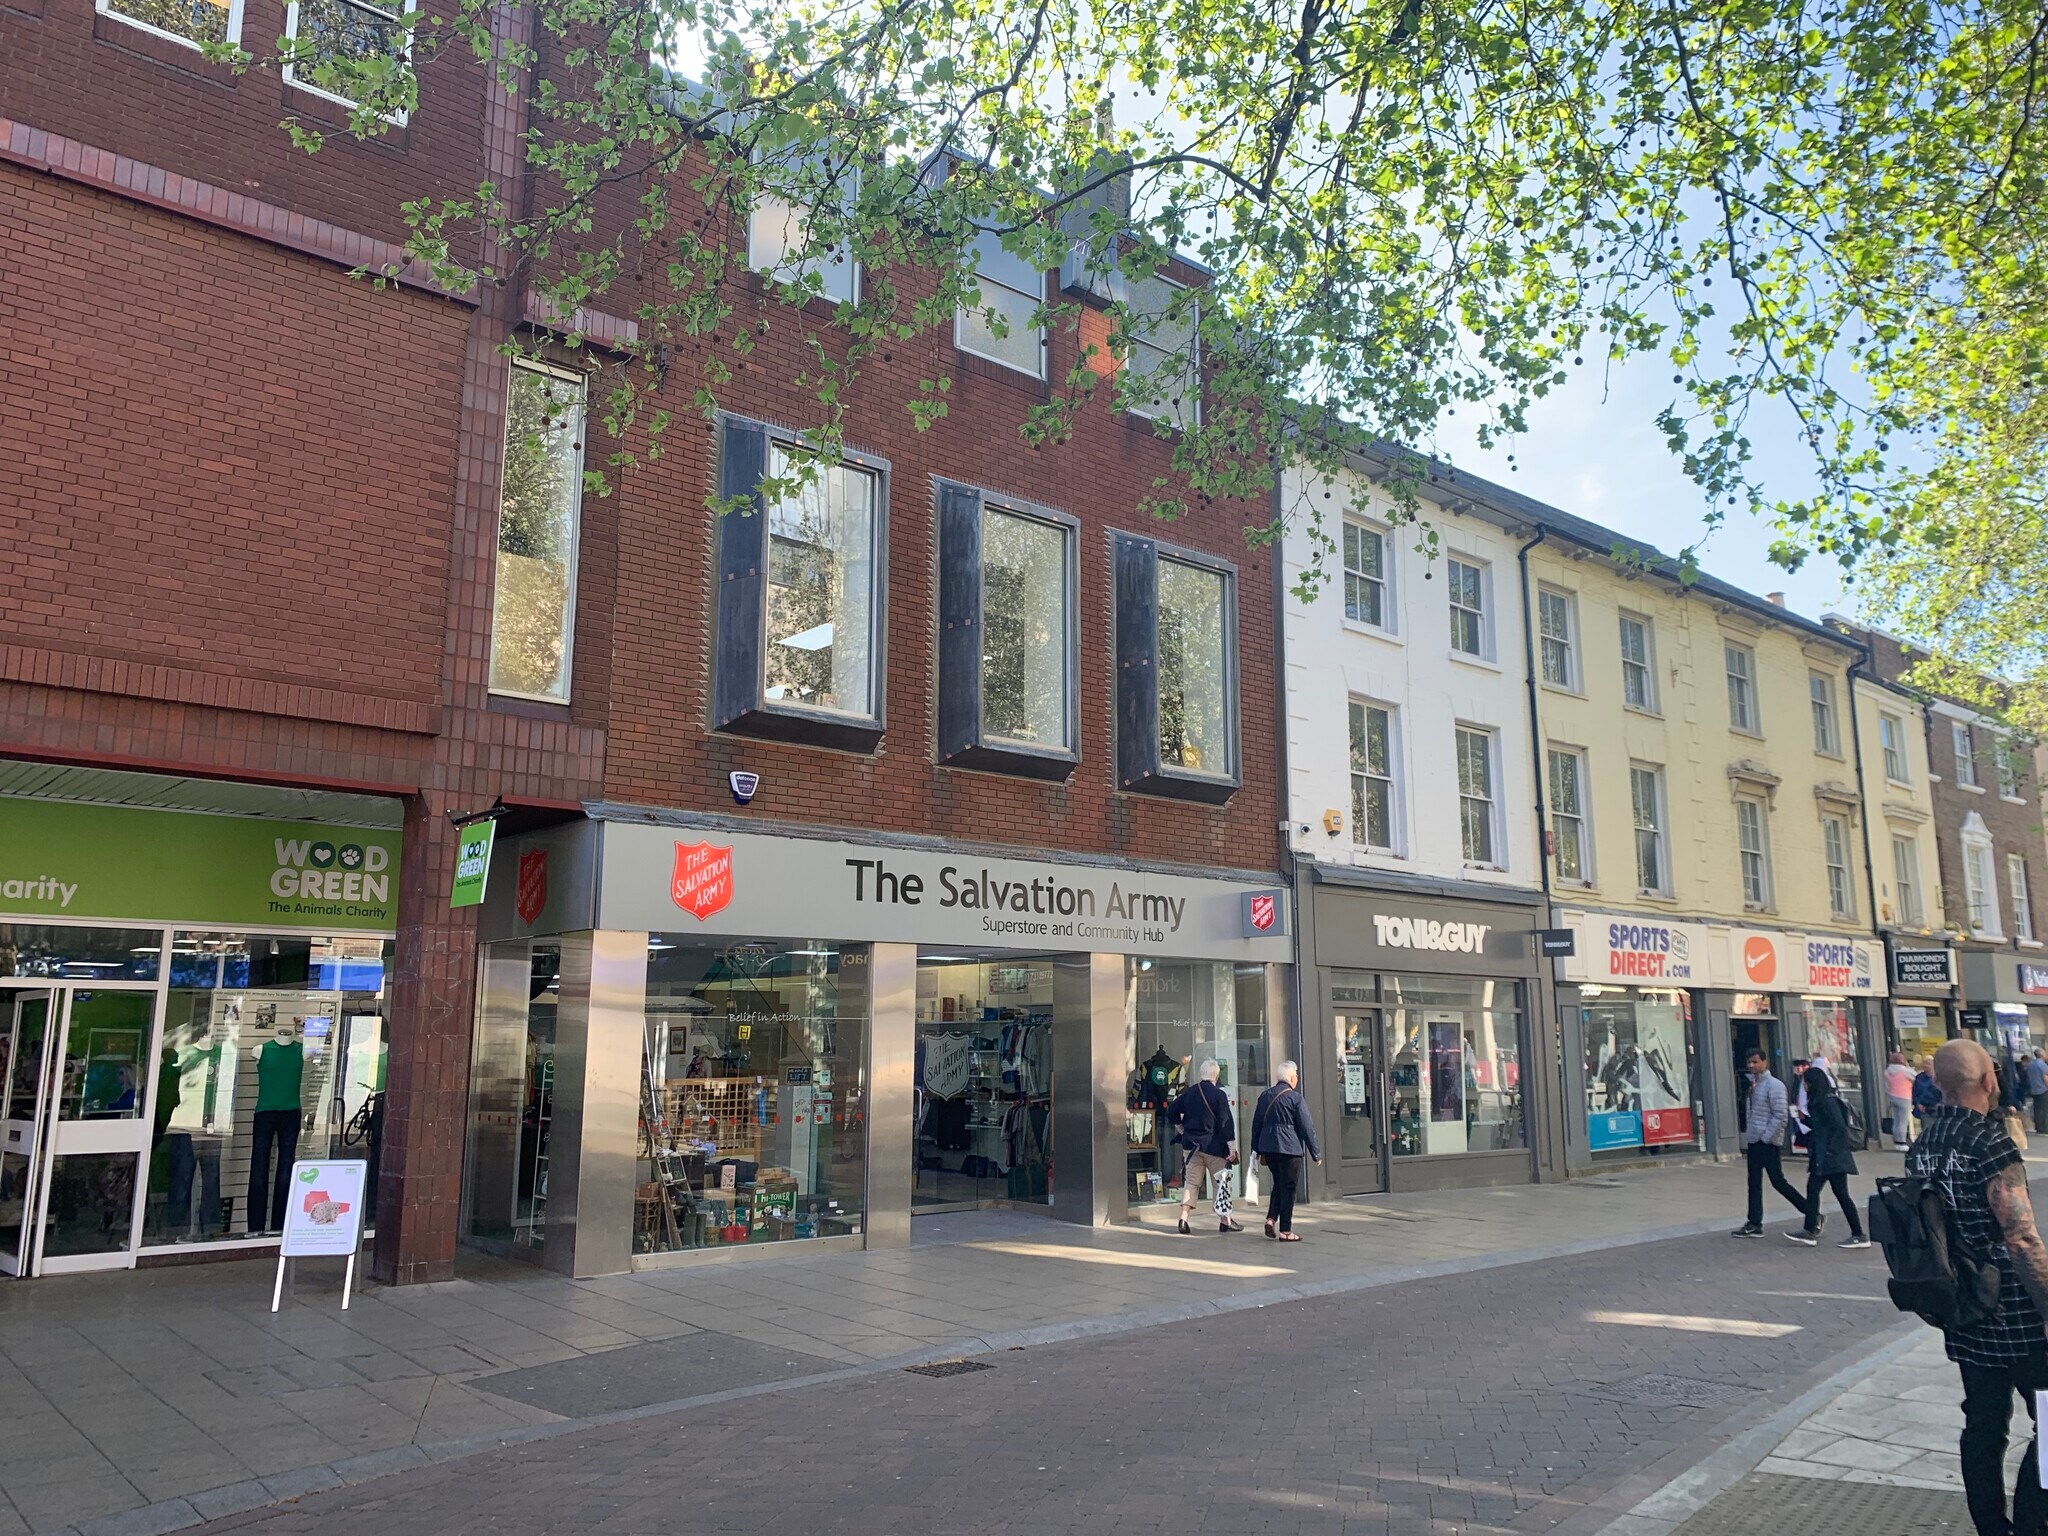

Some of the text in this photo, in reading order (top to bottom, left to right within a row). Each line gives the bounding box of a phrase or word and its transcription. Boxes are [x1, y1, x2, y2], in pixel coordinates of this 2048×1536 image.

[274, 838, 389, 872] WOOD
[462, 840, 486, 860] WOOD
[685, 847, 709, 872] THE
[458, 858, 484, 879] GREEN
[675, 853, 729, 899] SALVATION
[0, 874, 78, 908] arity
[270, 867, 389, 903] GREEN
[693, 875, 727, 911] ARMY
[846, 858, 1186, 933] The Salvation Army
[268, 901, 387, 920] The Animals Charity
[982, 916, 1165, 944] Superstore and Community Hub
[1609, 923, 1670, 952] SPORTS
[1610, 951, 1666, 977] DIRECT
[1808, 942, 1854, 967] SPORTS
[1898, 954, 1947, 963] DIAMONDS
[1809, 965, 1851, 988] DIRECT
[1902, 973, 1947, 981] FOR CASH
[1904, 964, 1942, 972] BOUGHT
[728, 1011, 801, 1025] Belief in Action
